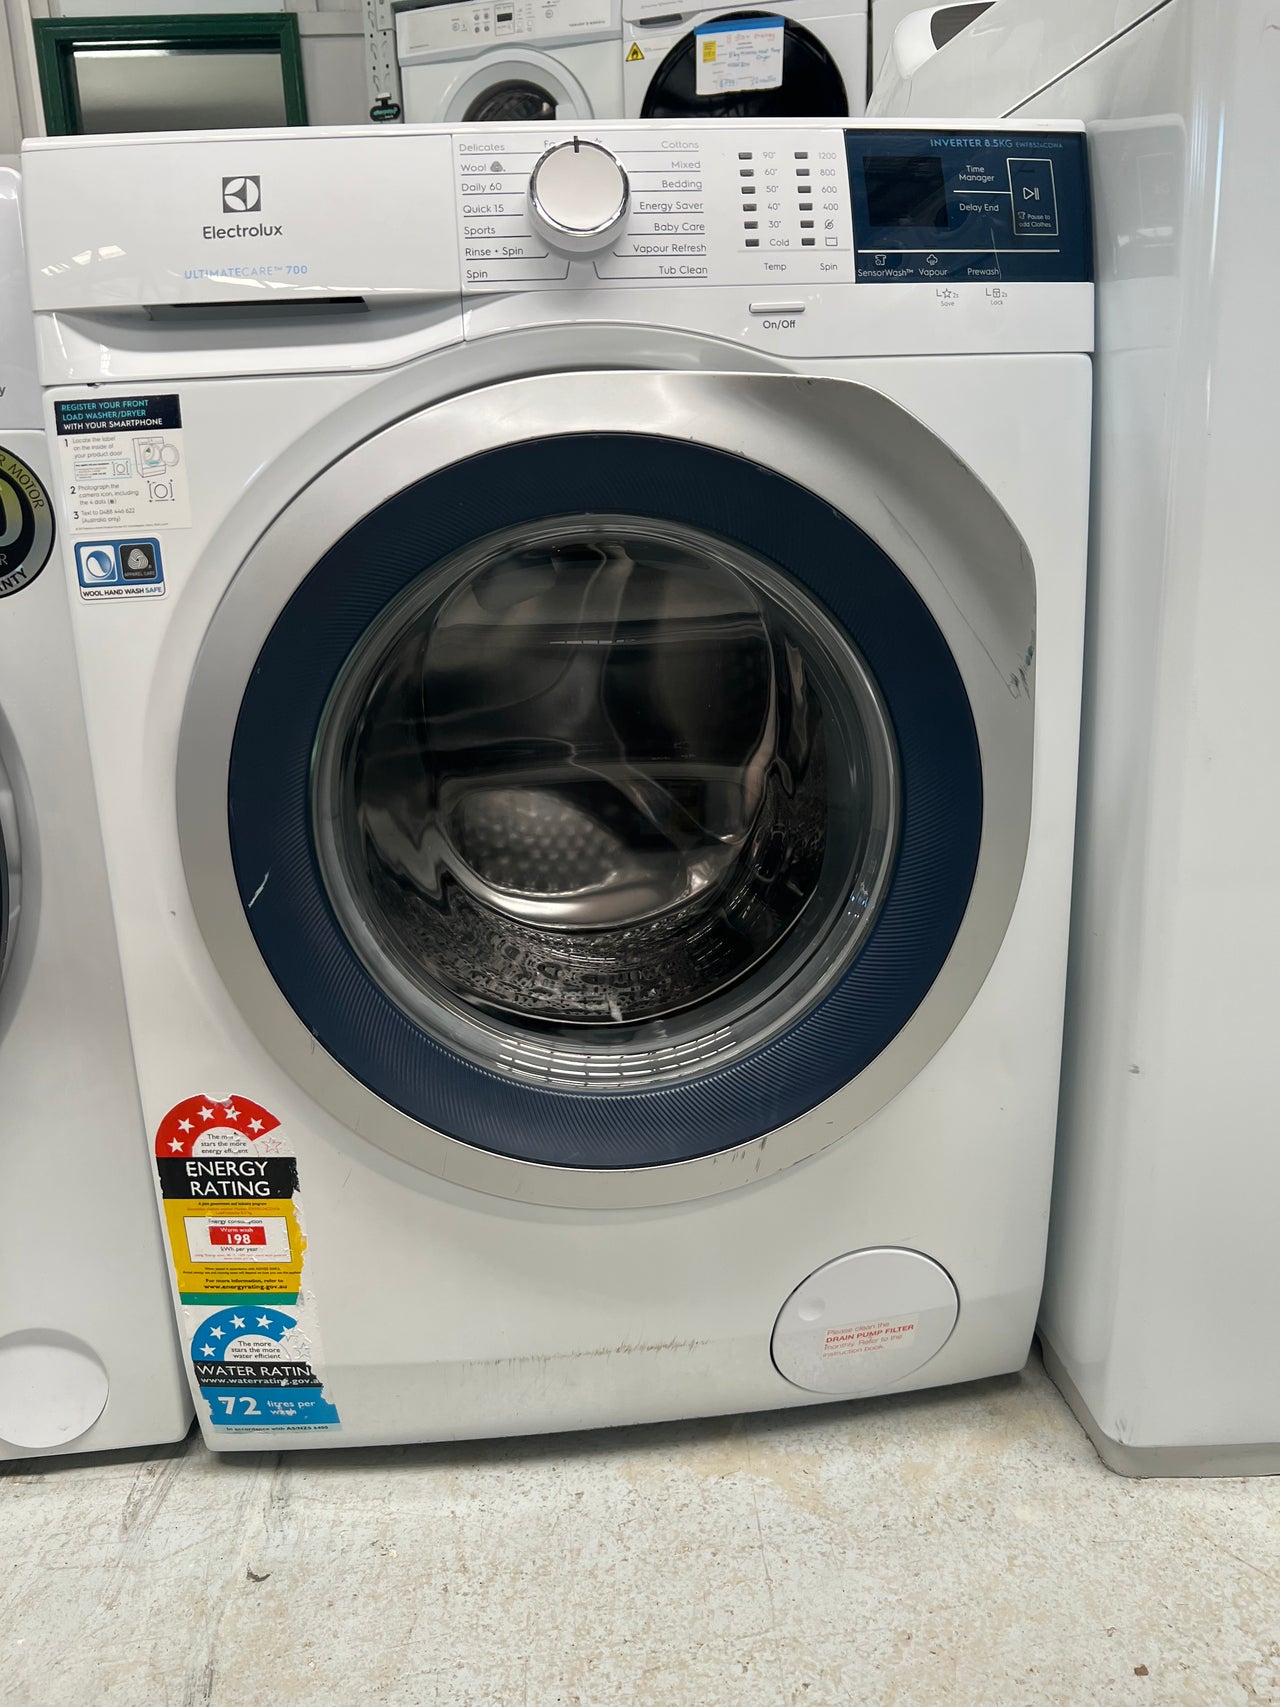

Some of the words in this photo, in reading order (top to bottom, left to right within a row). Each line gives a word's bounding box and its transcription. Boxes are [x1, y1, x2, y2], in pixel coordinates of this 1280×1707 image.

[459, 143, 505, 152] Delicates
[661, 141, 699, 149] Cottons
[930, 138, 982, 148] INVERTER
[984, 138, 1013, 148] 8.5KG
[818, 152, 837, 160] 1200
[461, 163, 487, 172] Wool
[671, 161, 701, 169] Mixed
[966, 165, 985, 173] Time
[819, 168, 836, 176] 800
[958, 174, 995, 183] Manager
[461, 183, 487, 193] Daily
[489, 183, 502, 191] 60
[662, 180, 702, 189] Bedding
[821, 186, 838, 194] 600
[463, 205, 492, 214] Quick
[494, 204, 504, 213] 15
[640, 202, 673, 212] Energy
[676, 202, 703, 210] Saver
[823, 203, 839, 211] 400
[959, 203, 982, 212] Delay
[984, 203, 999, 212] End
[202, 223, 283, 239] Electrolux
[464, 226, 496, 236] Sports
[654, 222, 679, 232] Baby
[681, 222, 705, 231] Care
[769, 238, 790, 247] Cold
[465, 248, 491, 256] Rinse
[502, 247, 524, 257] Spin
[633, 244, 669, 254] Vapour
[672, 243, 707, 252] Refresh
[286, 265, 308, 275] 700
[659, 266, 677, 274] Tub
[679, 265, 708, 274] Clean
[764, 262, 787, 272] Temp
[819, 262, 838, 272] Spin
[967, 267, 1000, 276] Prewash
[466, 270, 488, 279] Spin
[918, 268, 948, 277] Vapour
[940, 300, 955, 308] Save
[762, 319, 796, 330] On/Off
[61, 403, 97, 412] REGISTER
[98, 401, 120, 409] YOUR
[123, 400, 149, 408] FRONT
[62, 413, 84, 421] LOAD
[85, 409, 147, 420] WASHER/DRYER
[63, 422, 84, 430] WITH
[85, 421, 107, 430] YOUR
[109, 418, 163, 428] SMARTPHONE
[64, 439, 69, 447] 1
[8, 463, 45, 508] MOTOR
[70, 486, 76, 494] 2
[73, 511, 79, 520] 3
[185, 1161, 268, 1177] ENERGY
[190, 1181, 271, 1196] RATING
[226, 1234, 251, 1244] 198
[826, 1335, 854, 1343] DRAIN
[856, 1330, 883, 1339] PUMP
[884, 1324, 914, 1334] FILTER
[827, 1327, 853, 1335] Please
[855, 1324, 875, 1332] clean
[822, 1348, 862, 1358] instruction
[197, 1365, 257, 1377] WATER
[260, 1366, 312, 1377] RATIN
[217, 1396, 262, 1415] 72
